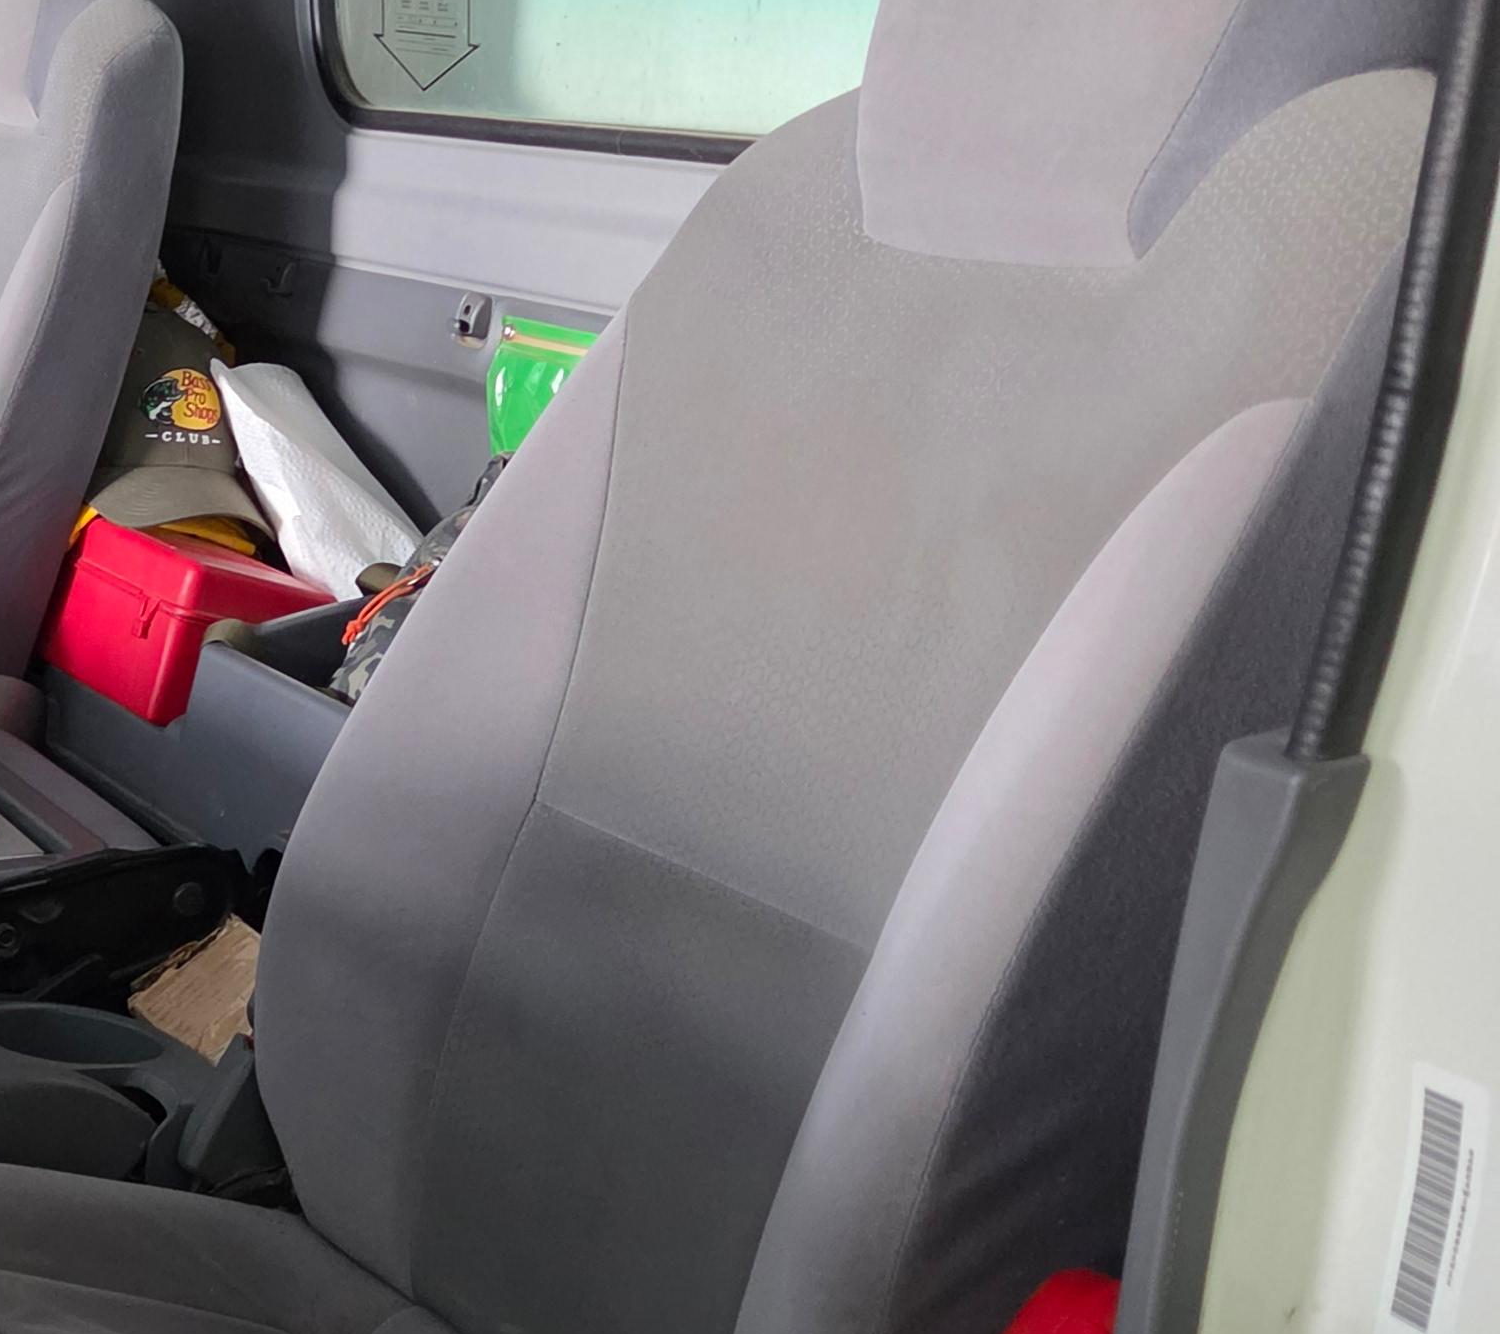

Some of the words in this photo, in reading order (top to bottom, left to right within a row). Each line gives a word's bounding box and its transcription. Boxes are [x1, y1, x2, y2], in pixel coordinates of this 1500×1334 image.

[182, 371, 211, 392] Bass
[184, 388, 207, 405] Pro
[183, 402, 218, 424] Shops
[161, 431, 210, 445] CLUB
